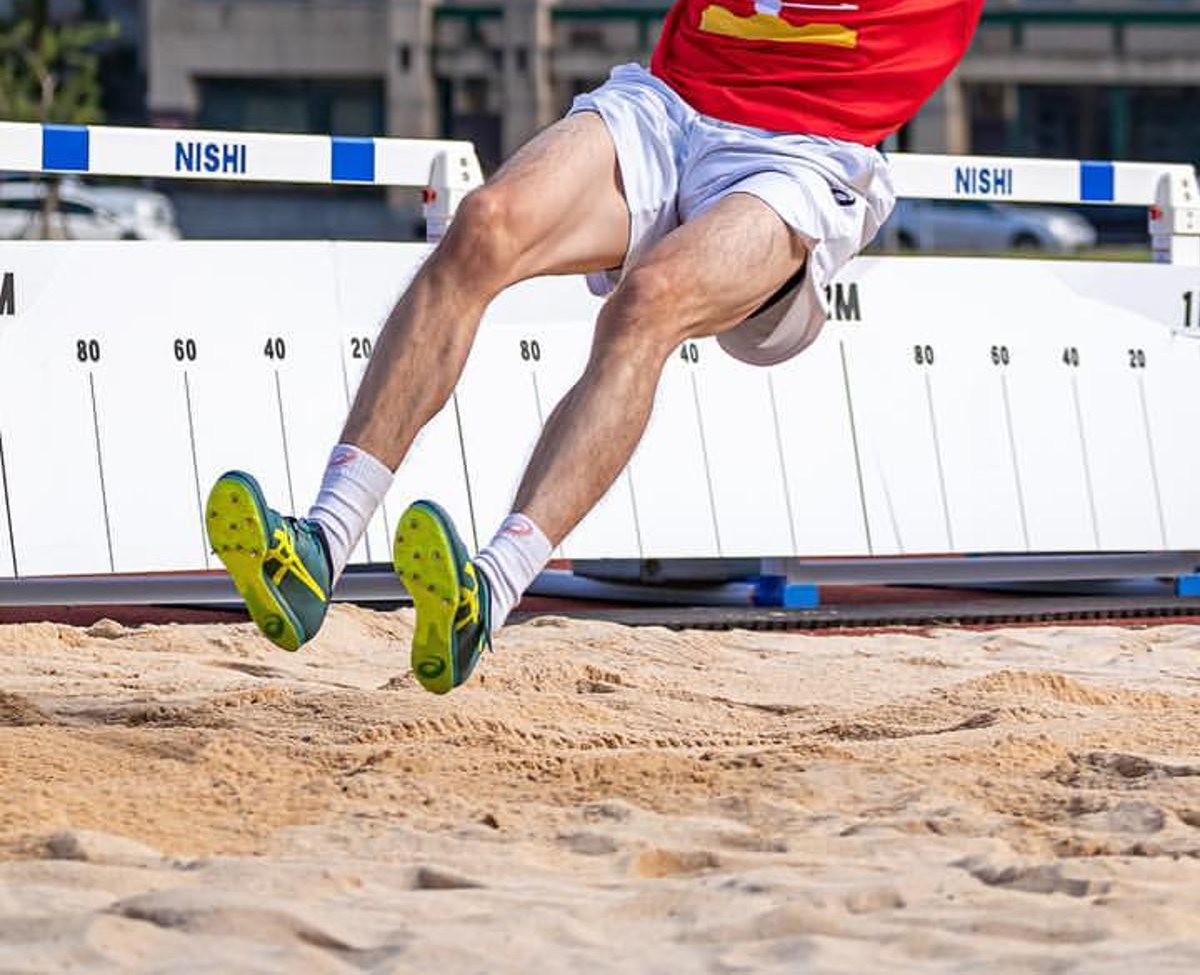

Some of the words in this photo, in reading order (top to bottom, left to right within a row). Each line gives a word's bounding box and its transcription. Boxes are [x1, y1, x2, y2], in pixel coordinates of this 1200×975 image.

[175, 141, 247, 174] NISHI
[954, 167, 1013, 196] NISHI
[76, 339, 101, 363] 80
[173, 338, 197, 362] 60
[263, 337, 286, 360] 40
[350, 336, 372, 360] 20
[519, 340, 541, 361] 80
[680, 343, 699, 364] 40
[914, 344, 934, 365] 80
[991, 345, 1010, 366] 60
[1062, 347, 1079, 367] 40
[1128, 349, 1146, 368] 20
